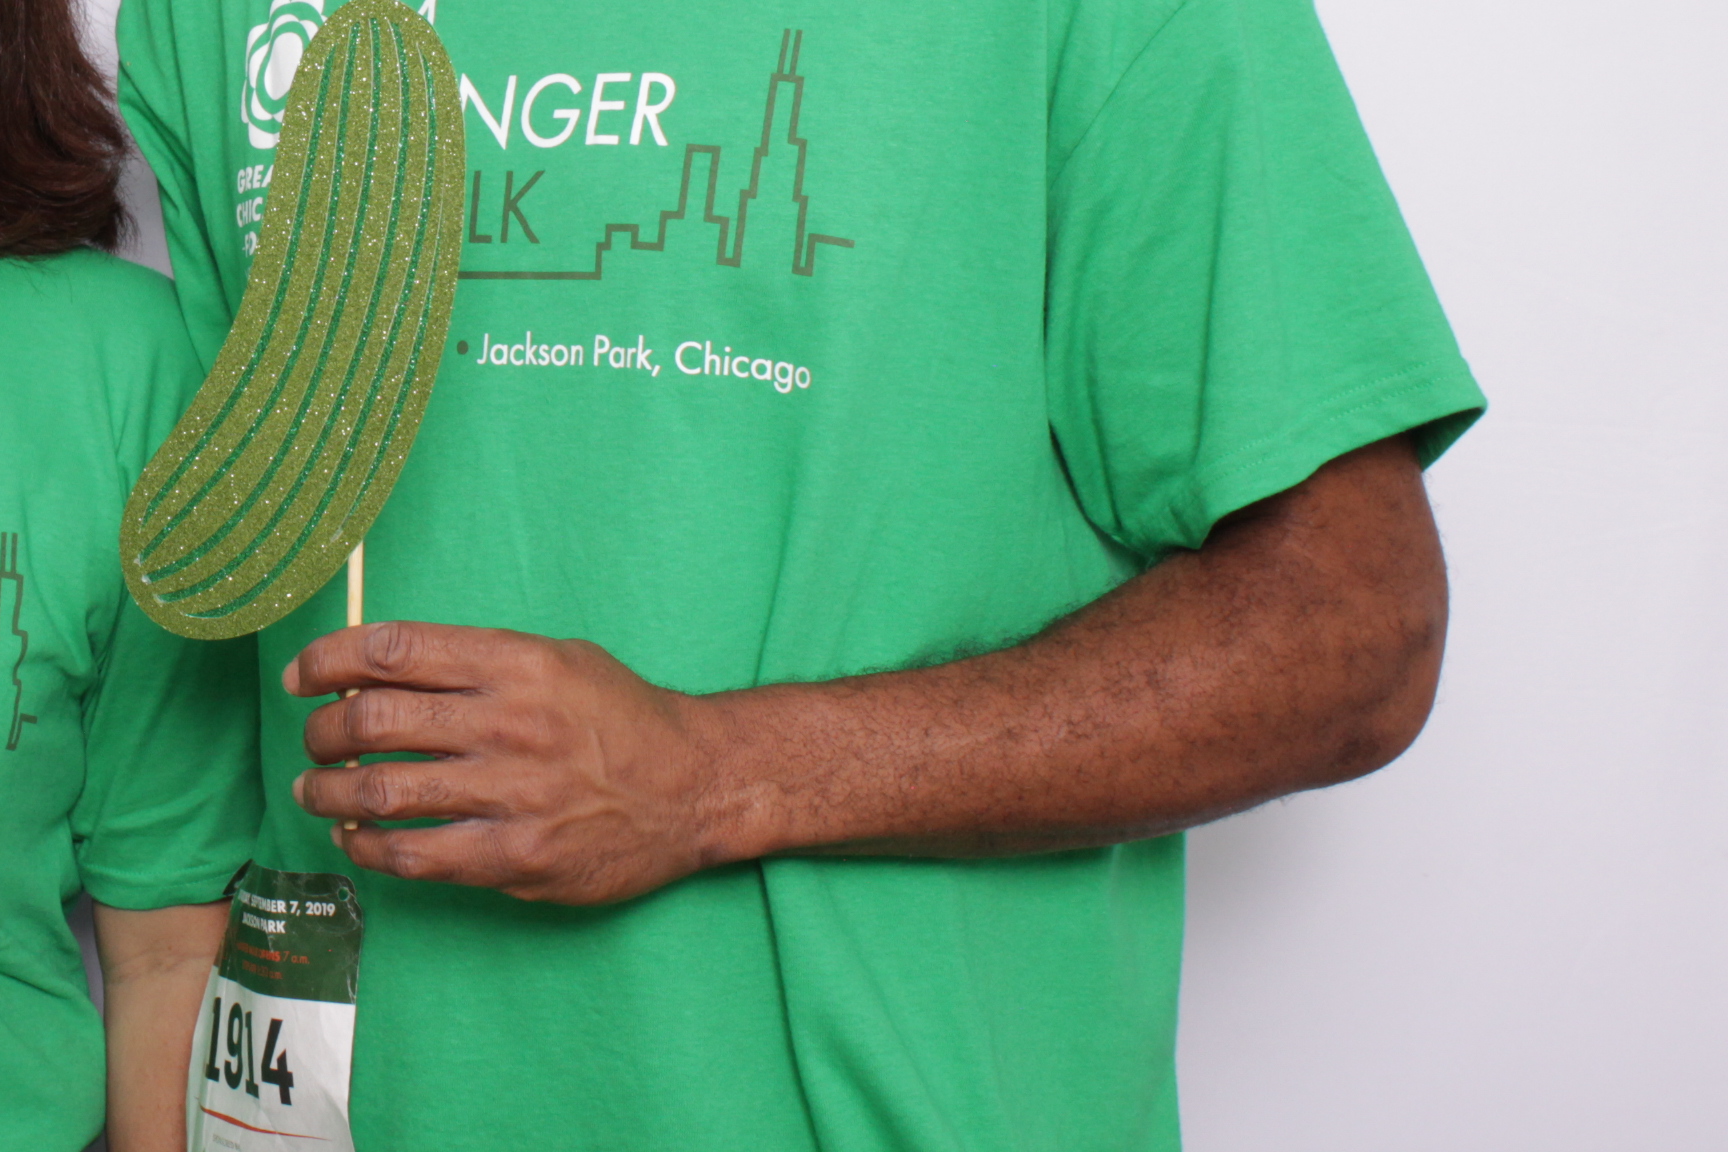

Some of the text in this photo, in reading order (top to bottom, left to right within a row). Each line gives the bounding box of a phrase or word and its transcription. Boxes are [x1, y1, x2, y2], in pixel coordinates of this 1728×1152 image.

[459, 72, 676, 150] NGER
[236, 197, 263, 227] CHIC
[469, 170, 545, 244] LK
[477, 331, 811, 394] Jackson Park, Chicago
[289, 901, 301, 916] 7,
[305, 901, 336, 916] 2019
[283, 951, 290, 961] 7
[291, 955, 310, 964] a.m.
